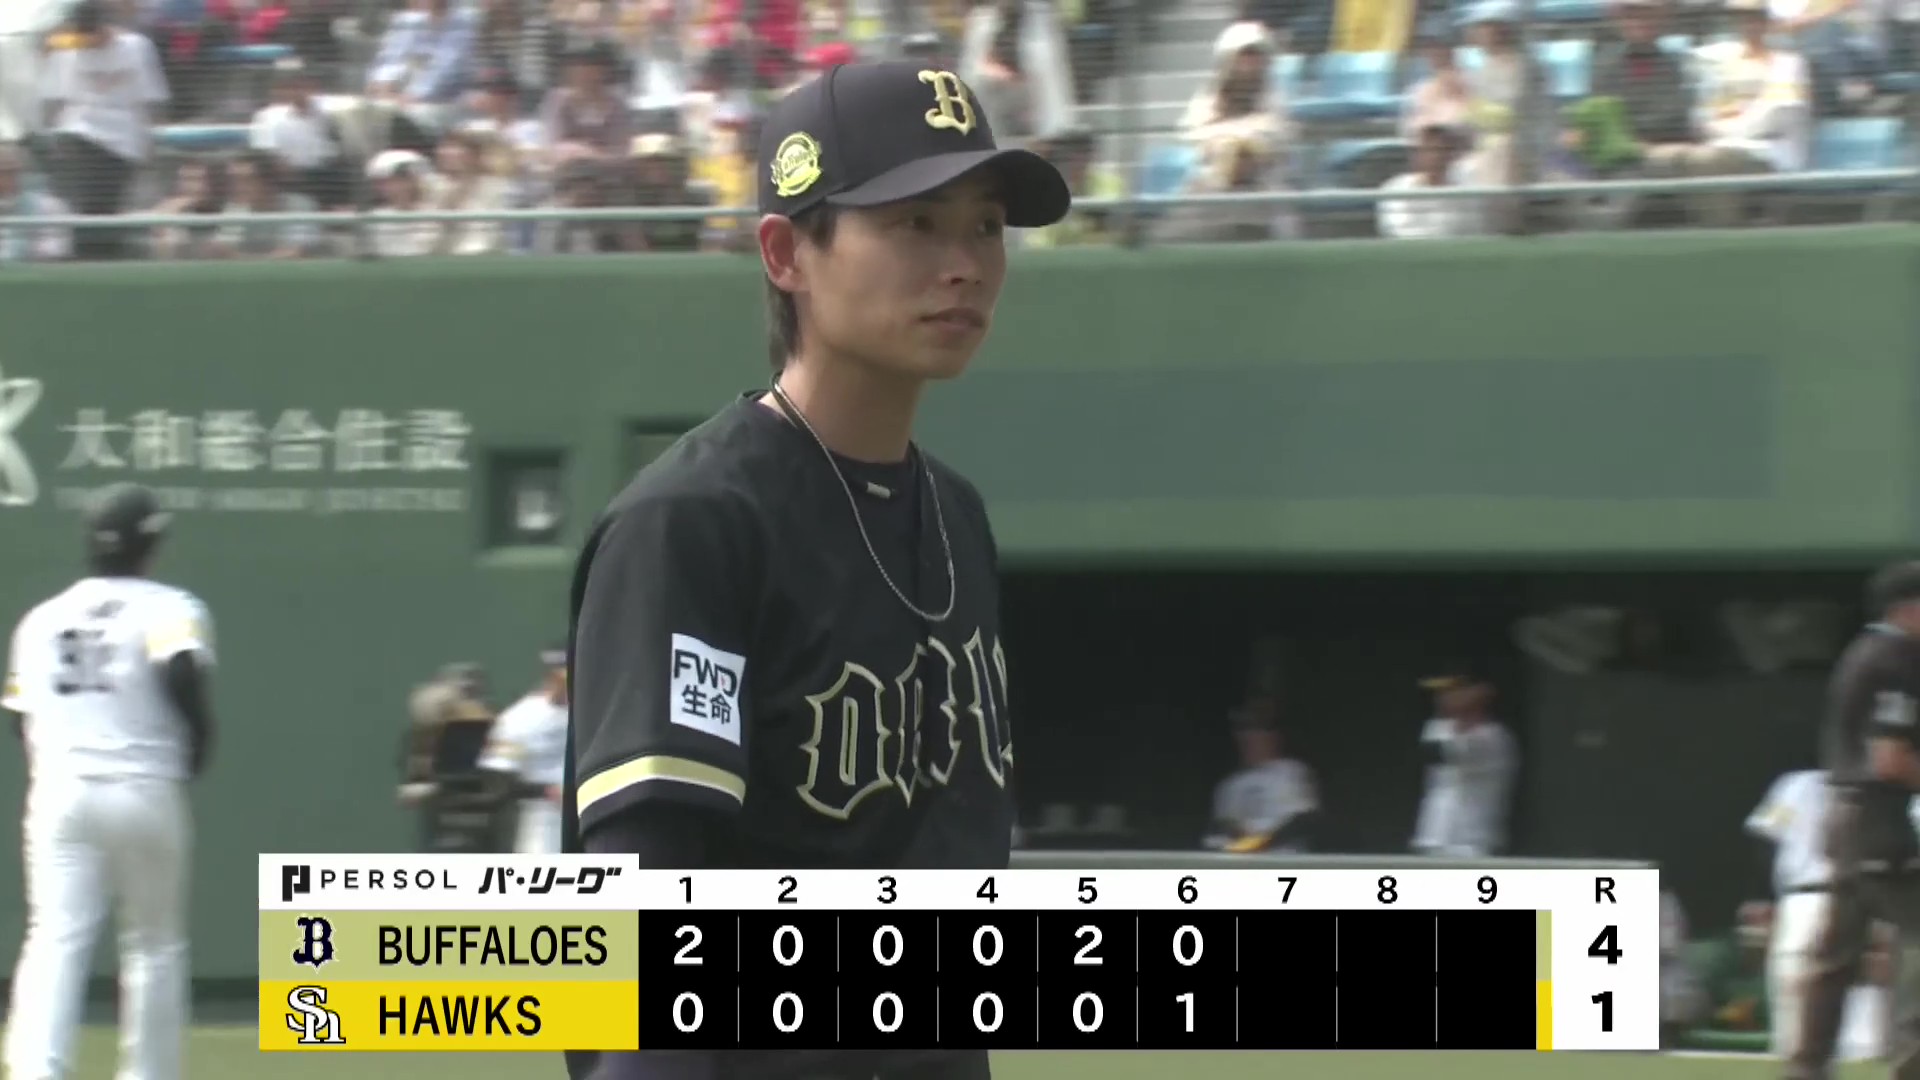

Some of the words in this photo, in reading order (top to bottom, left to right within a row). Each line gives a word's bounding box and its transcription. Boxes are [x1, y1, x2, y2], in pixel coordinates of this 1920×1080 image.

[918, 69, 976, 136] B
[674, 648, 738, 698] FWD
[682, 684, 732, 724] 生命
